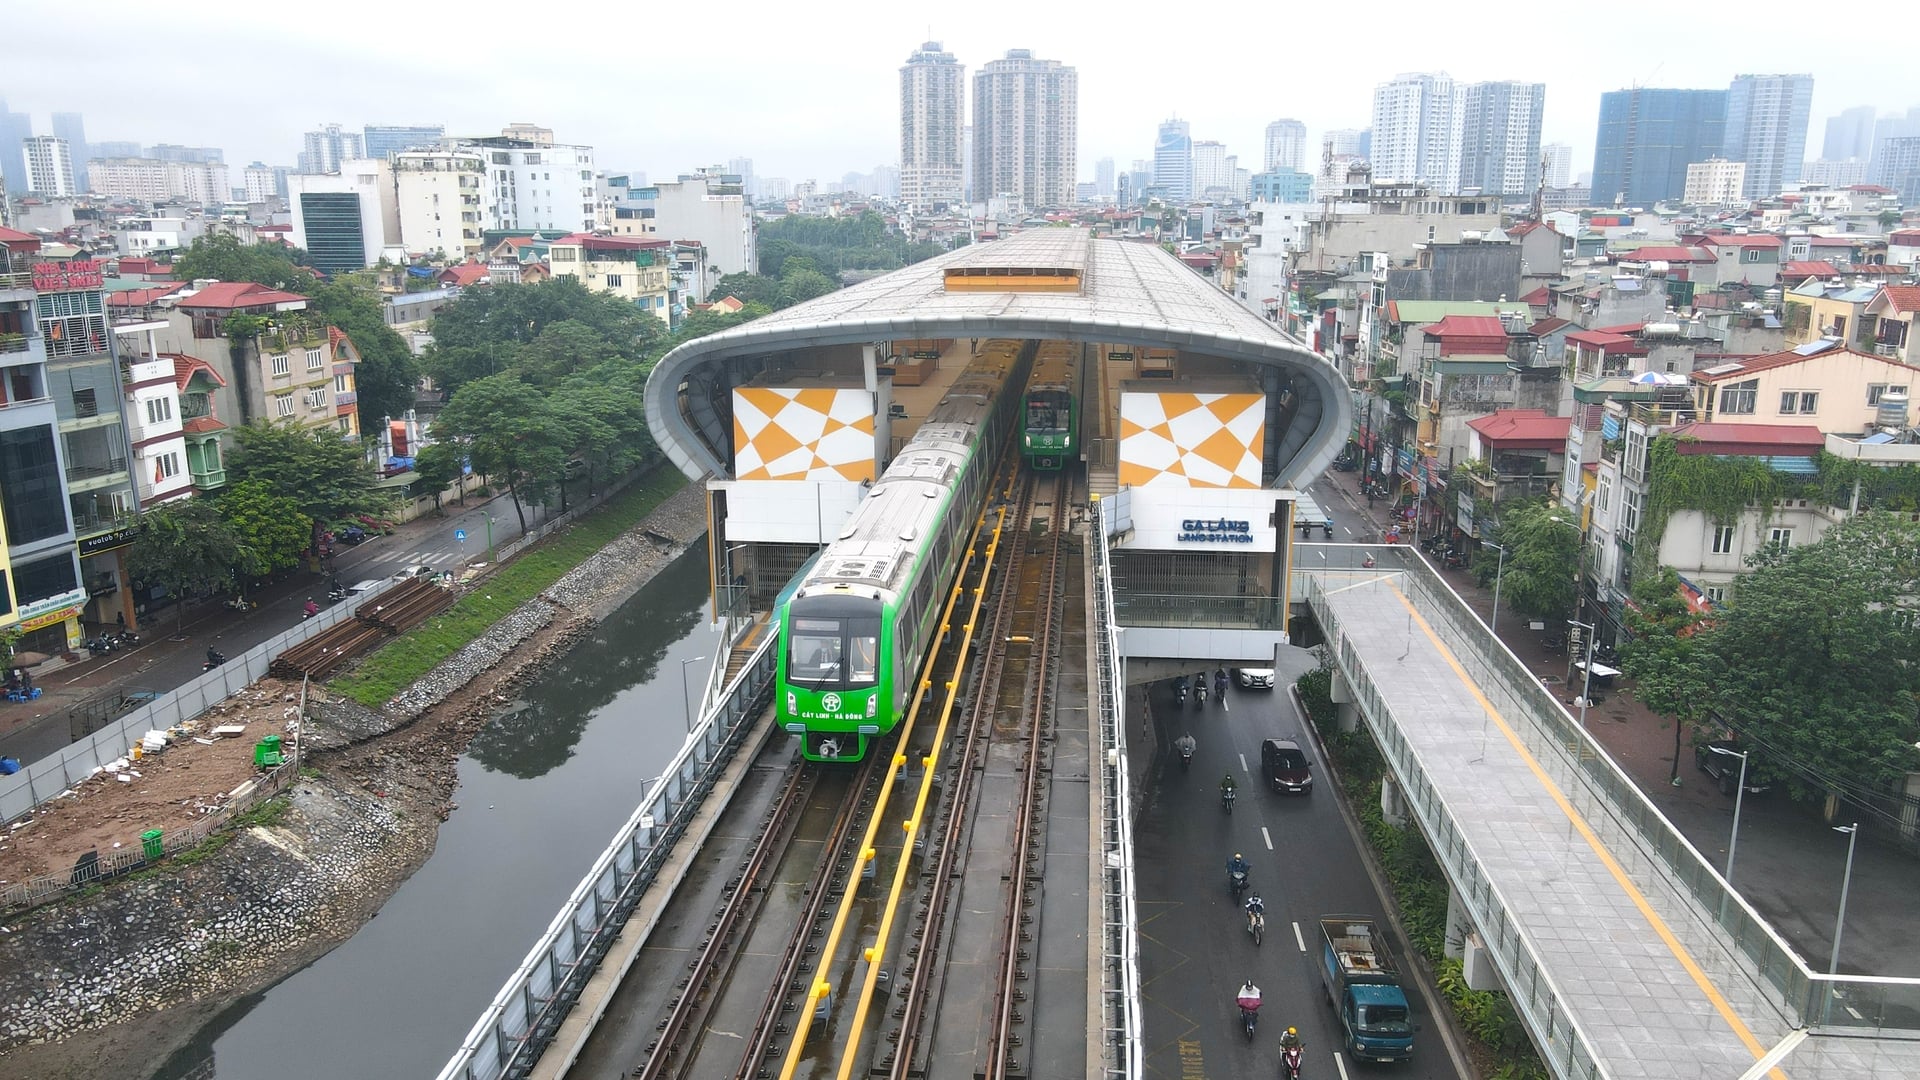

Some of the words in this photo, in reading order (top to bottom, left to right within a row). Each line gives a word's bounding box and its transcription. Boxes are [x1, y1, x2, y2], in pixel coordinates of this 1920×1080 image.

[34, 263, 61, 274] NHA
[1183, 520, 1203, 531] GA
[1208, 517, 1249, 532] LÁNG
[1178, 533, 1206, 542] LANG
[1207, 534, 1253, 543] STATION
